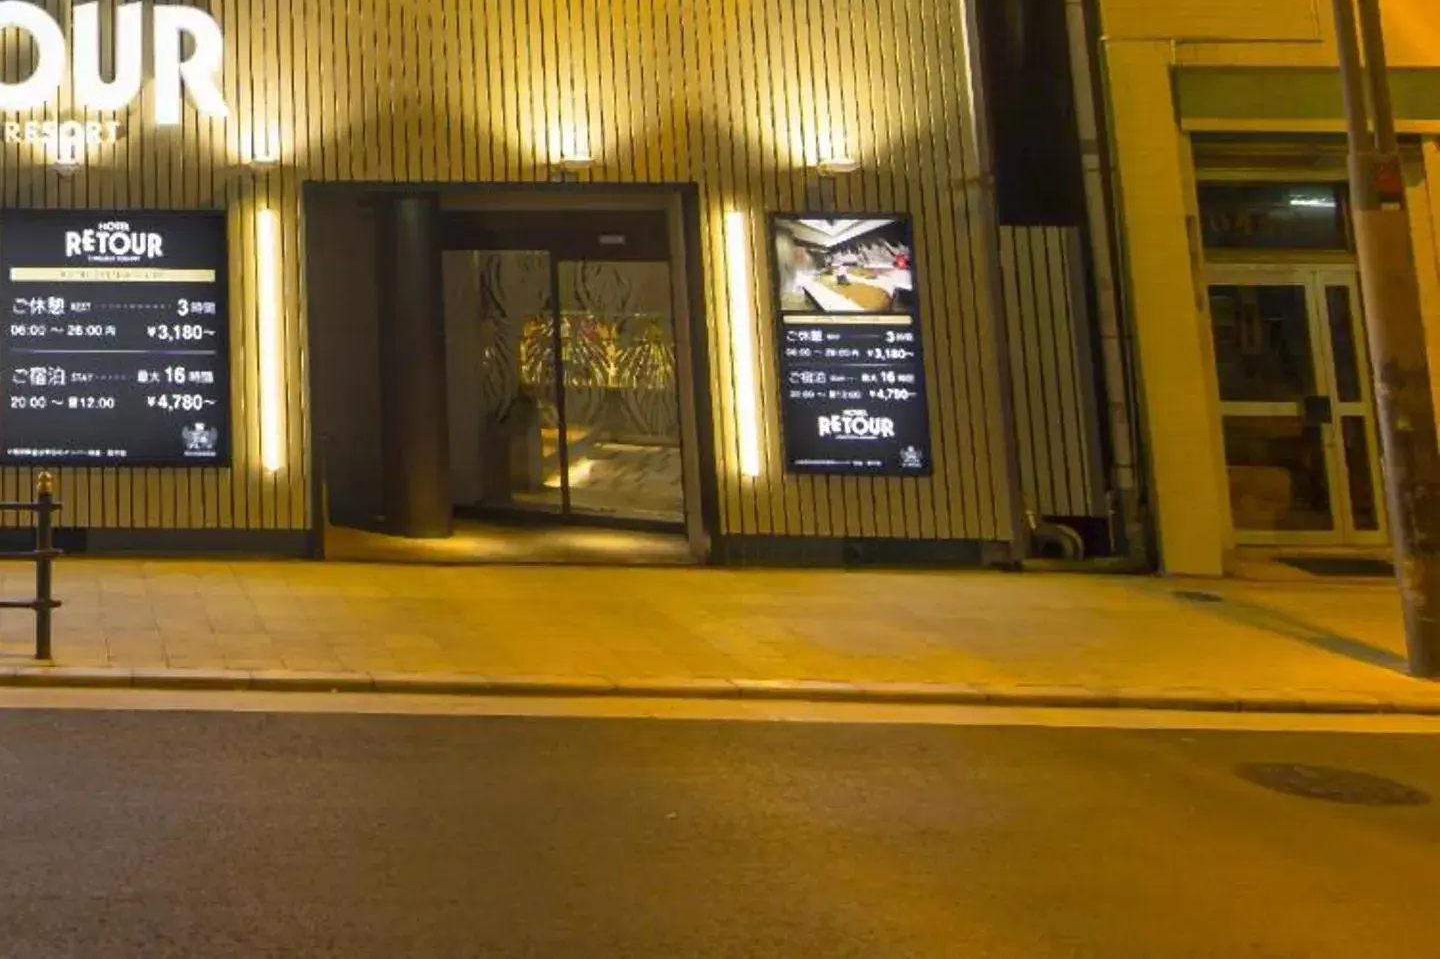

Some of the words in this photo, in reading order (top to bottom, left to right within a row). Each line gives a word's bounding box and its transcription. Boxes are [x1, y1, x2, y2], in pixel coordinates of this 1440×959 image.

[4, 120, 121, 145] RESORT
[64, 228, 163, 259] RETOUR
[817, 414, 896, 438] RETOUR
